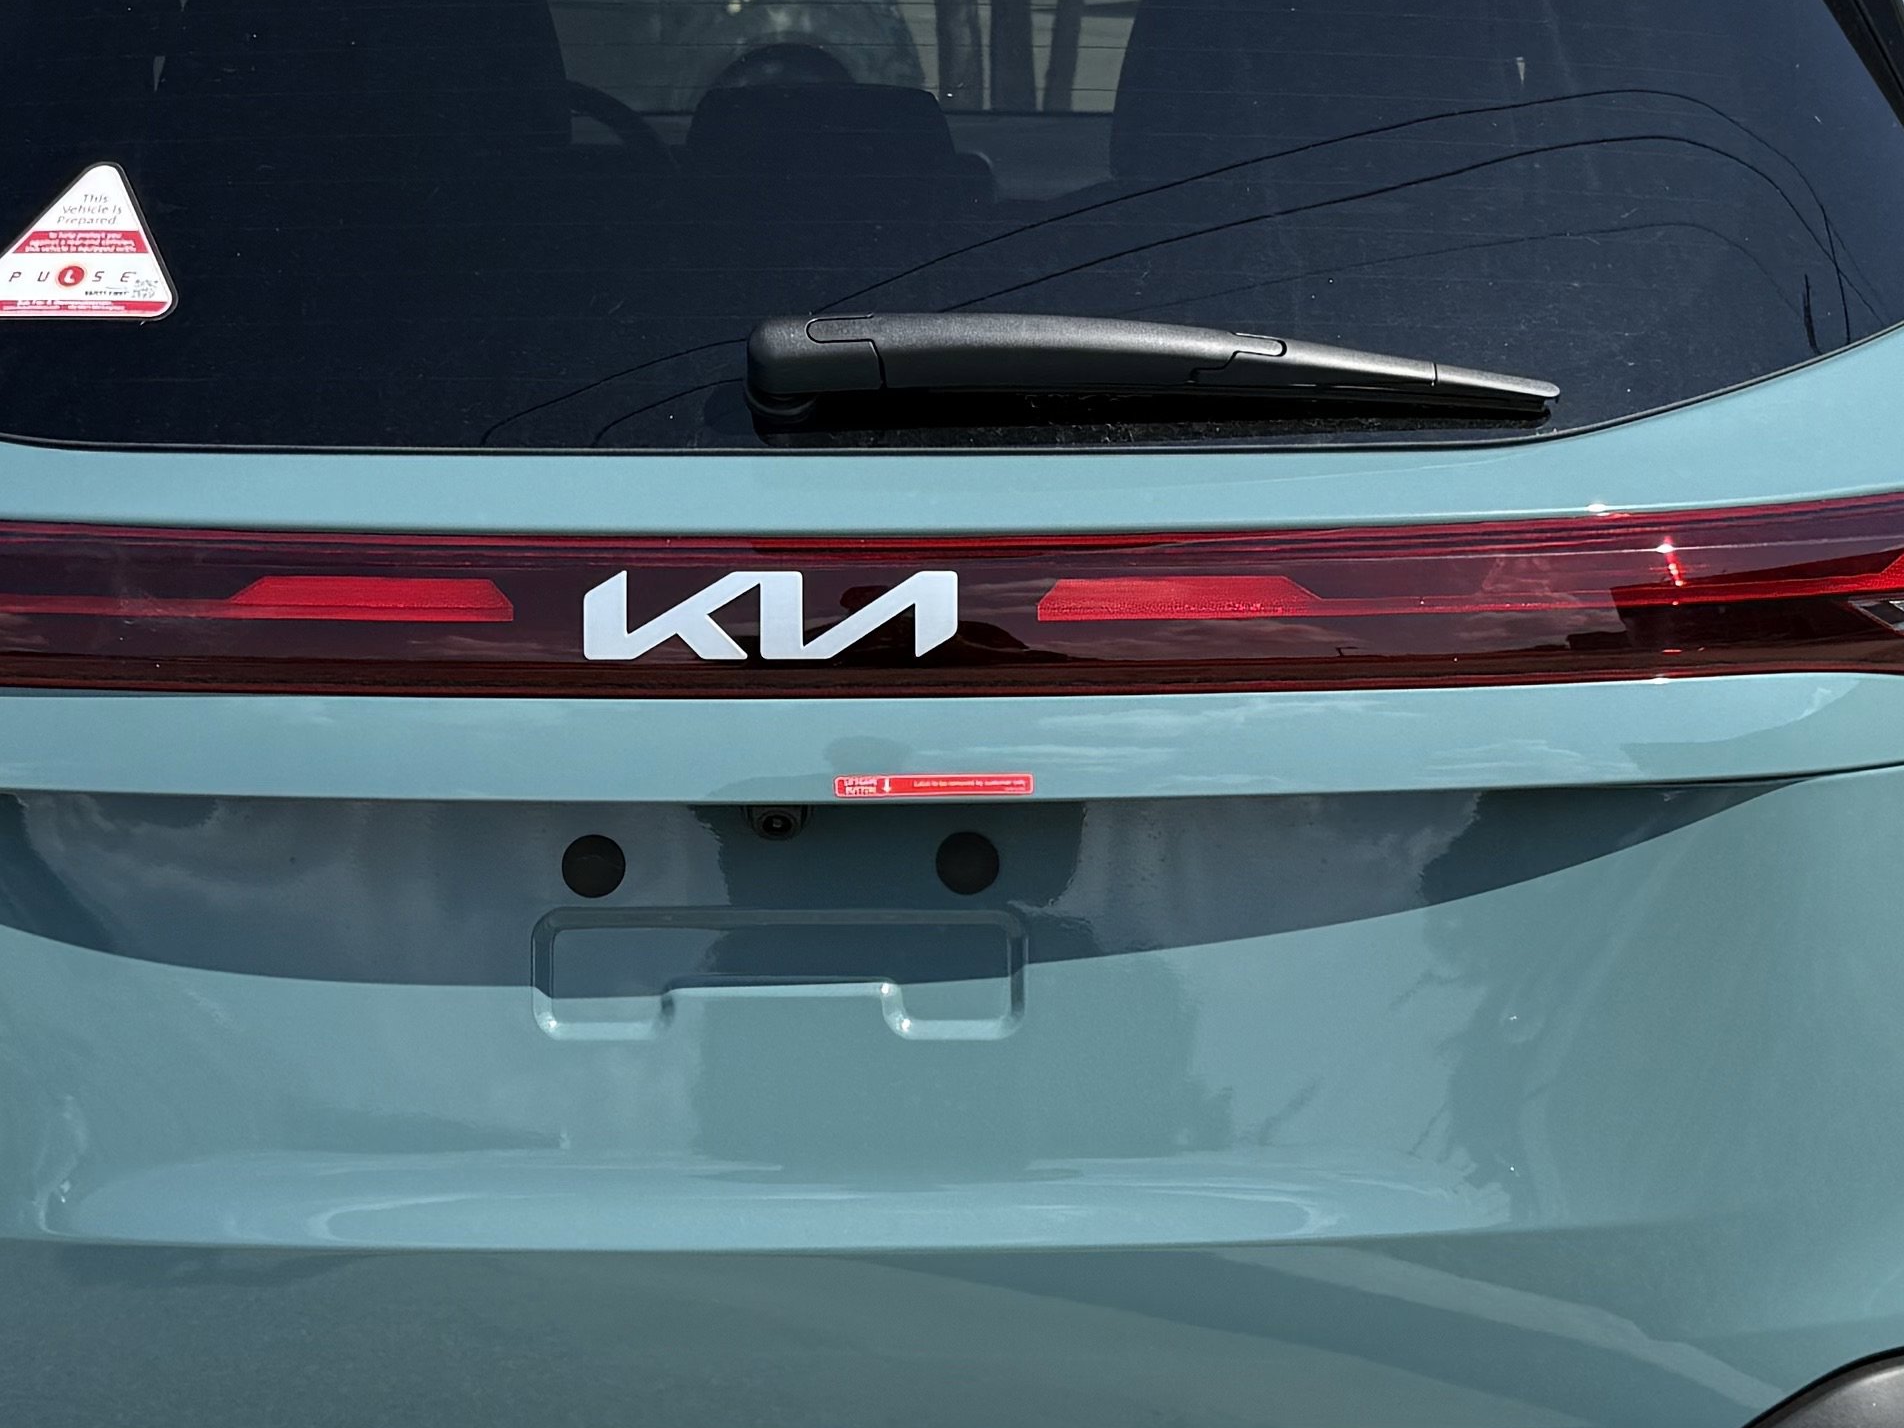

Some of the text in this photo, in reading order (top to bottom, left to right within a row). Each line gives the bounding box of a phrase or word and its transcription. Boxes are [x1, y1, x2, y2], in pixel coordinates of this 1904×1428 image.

[83, 194, 108, 203] This
[62, 205, 109, 214] Vehicle
[8, 270, 137, 284] PULSE
[583, 569, 959, 661] KIA
